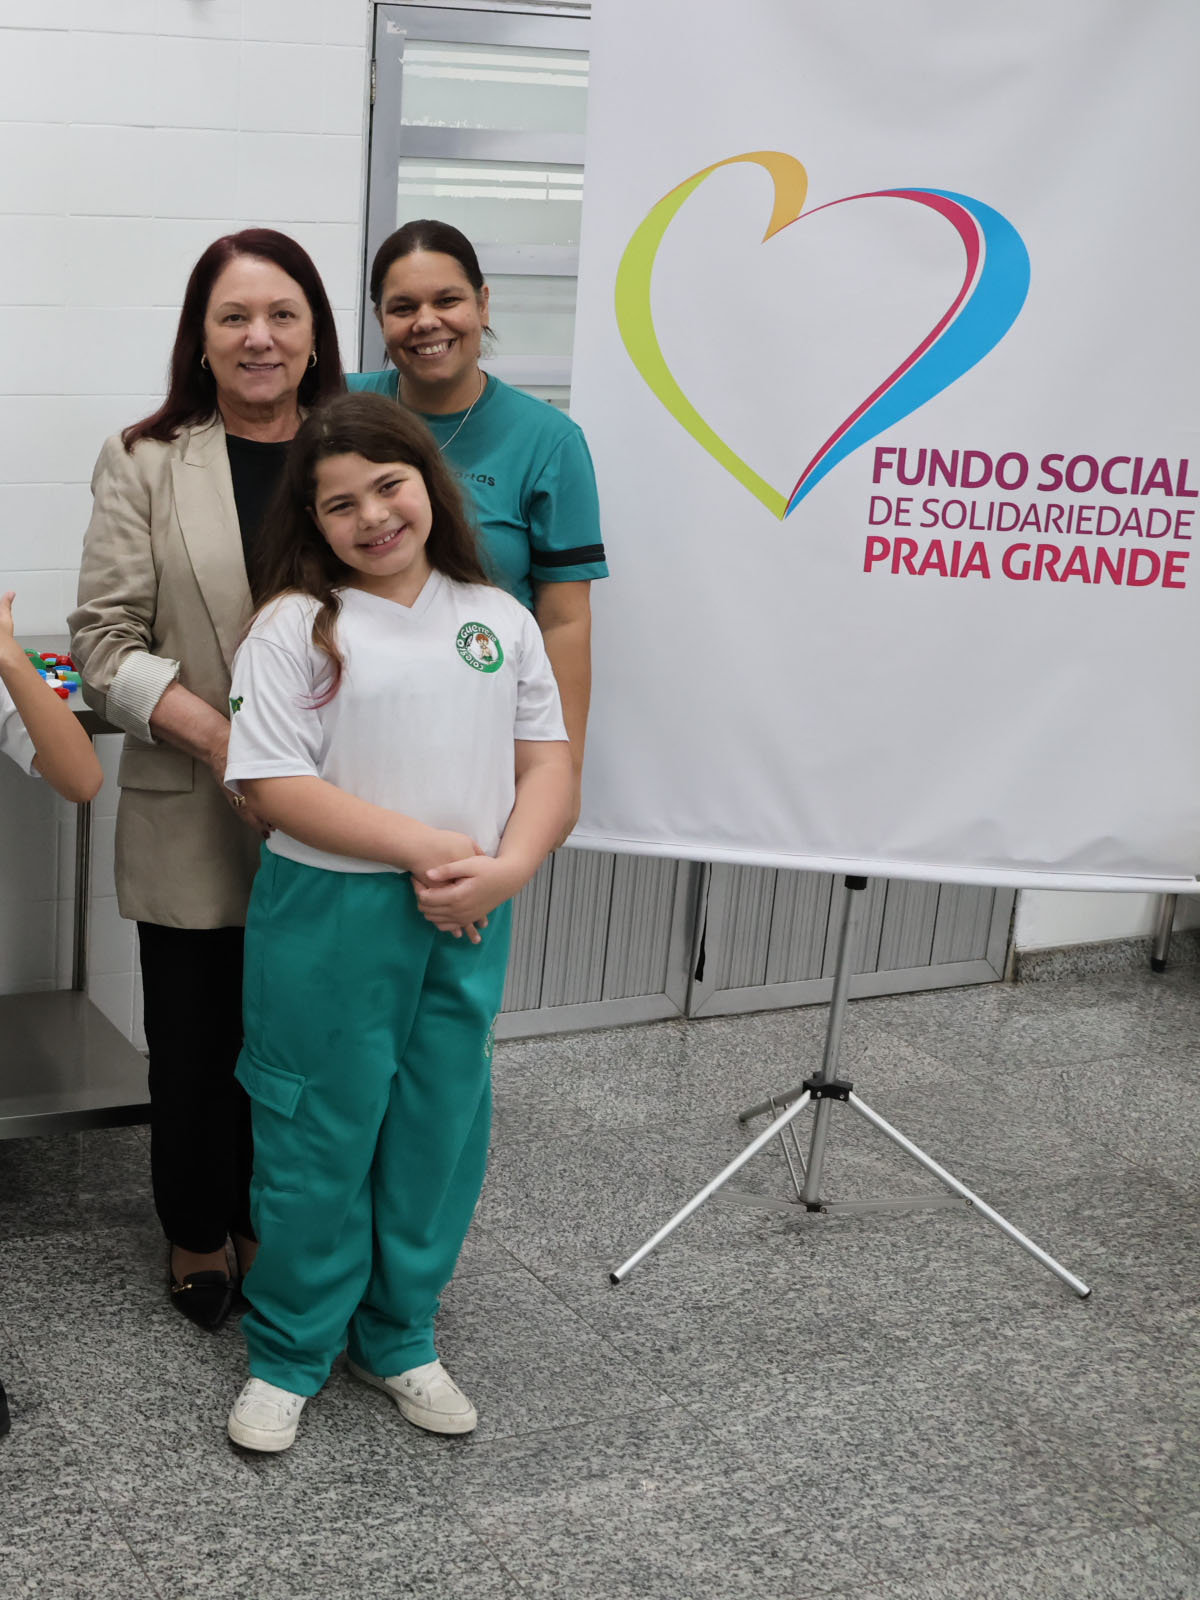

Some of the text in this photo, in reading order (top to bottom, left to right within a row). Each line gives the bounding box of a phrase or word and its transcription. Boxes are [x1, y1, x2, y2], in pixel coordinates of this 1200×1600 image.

[872, 446, 1199, 498] FUNDO SOCIAL
[867, 495, 1196, 541] DE SOLIDARIEDADE
[863, 535, 1190, 589] PRAIA GRANDE
